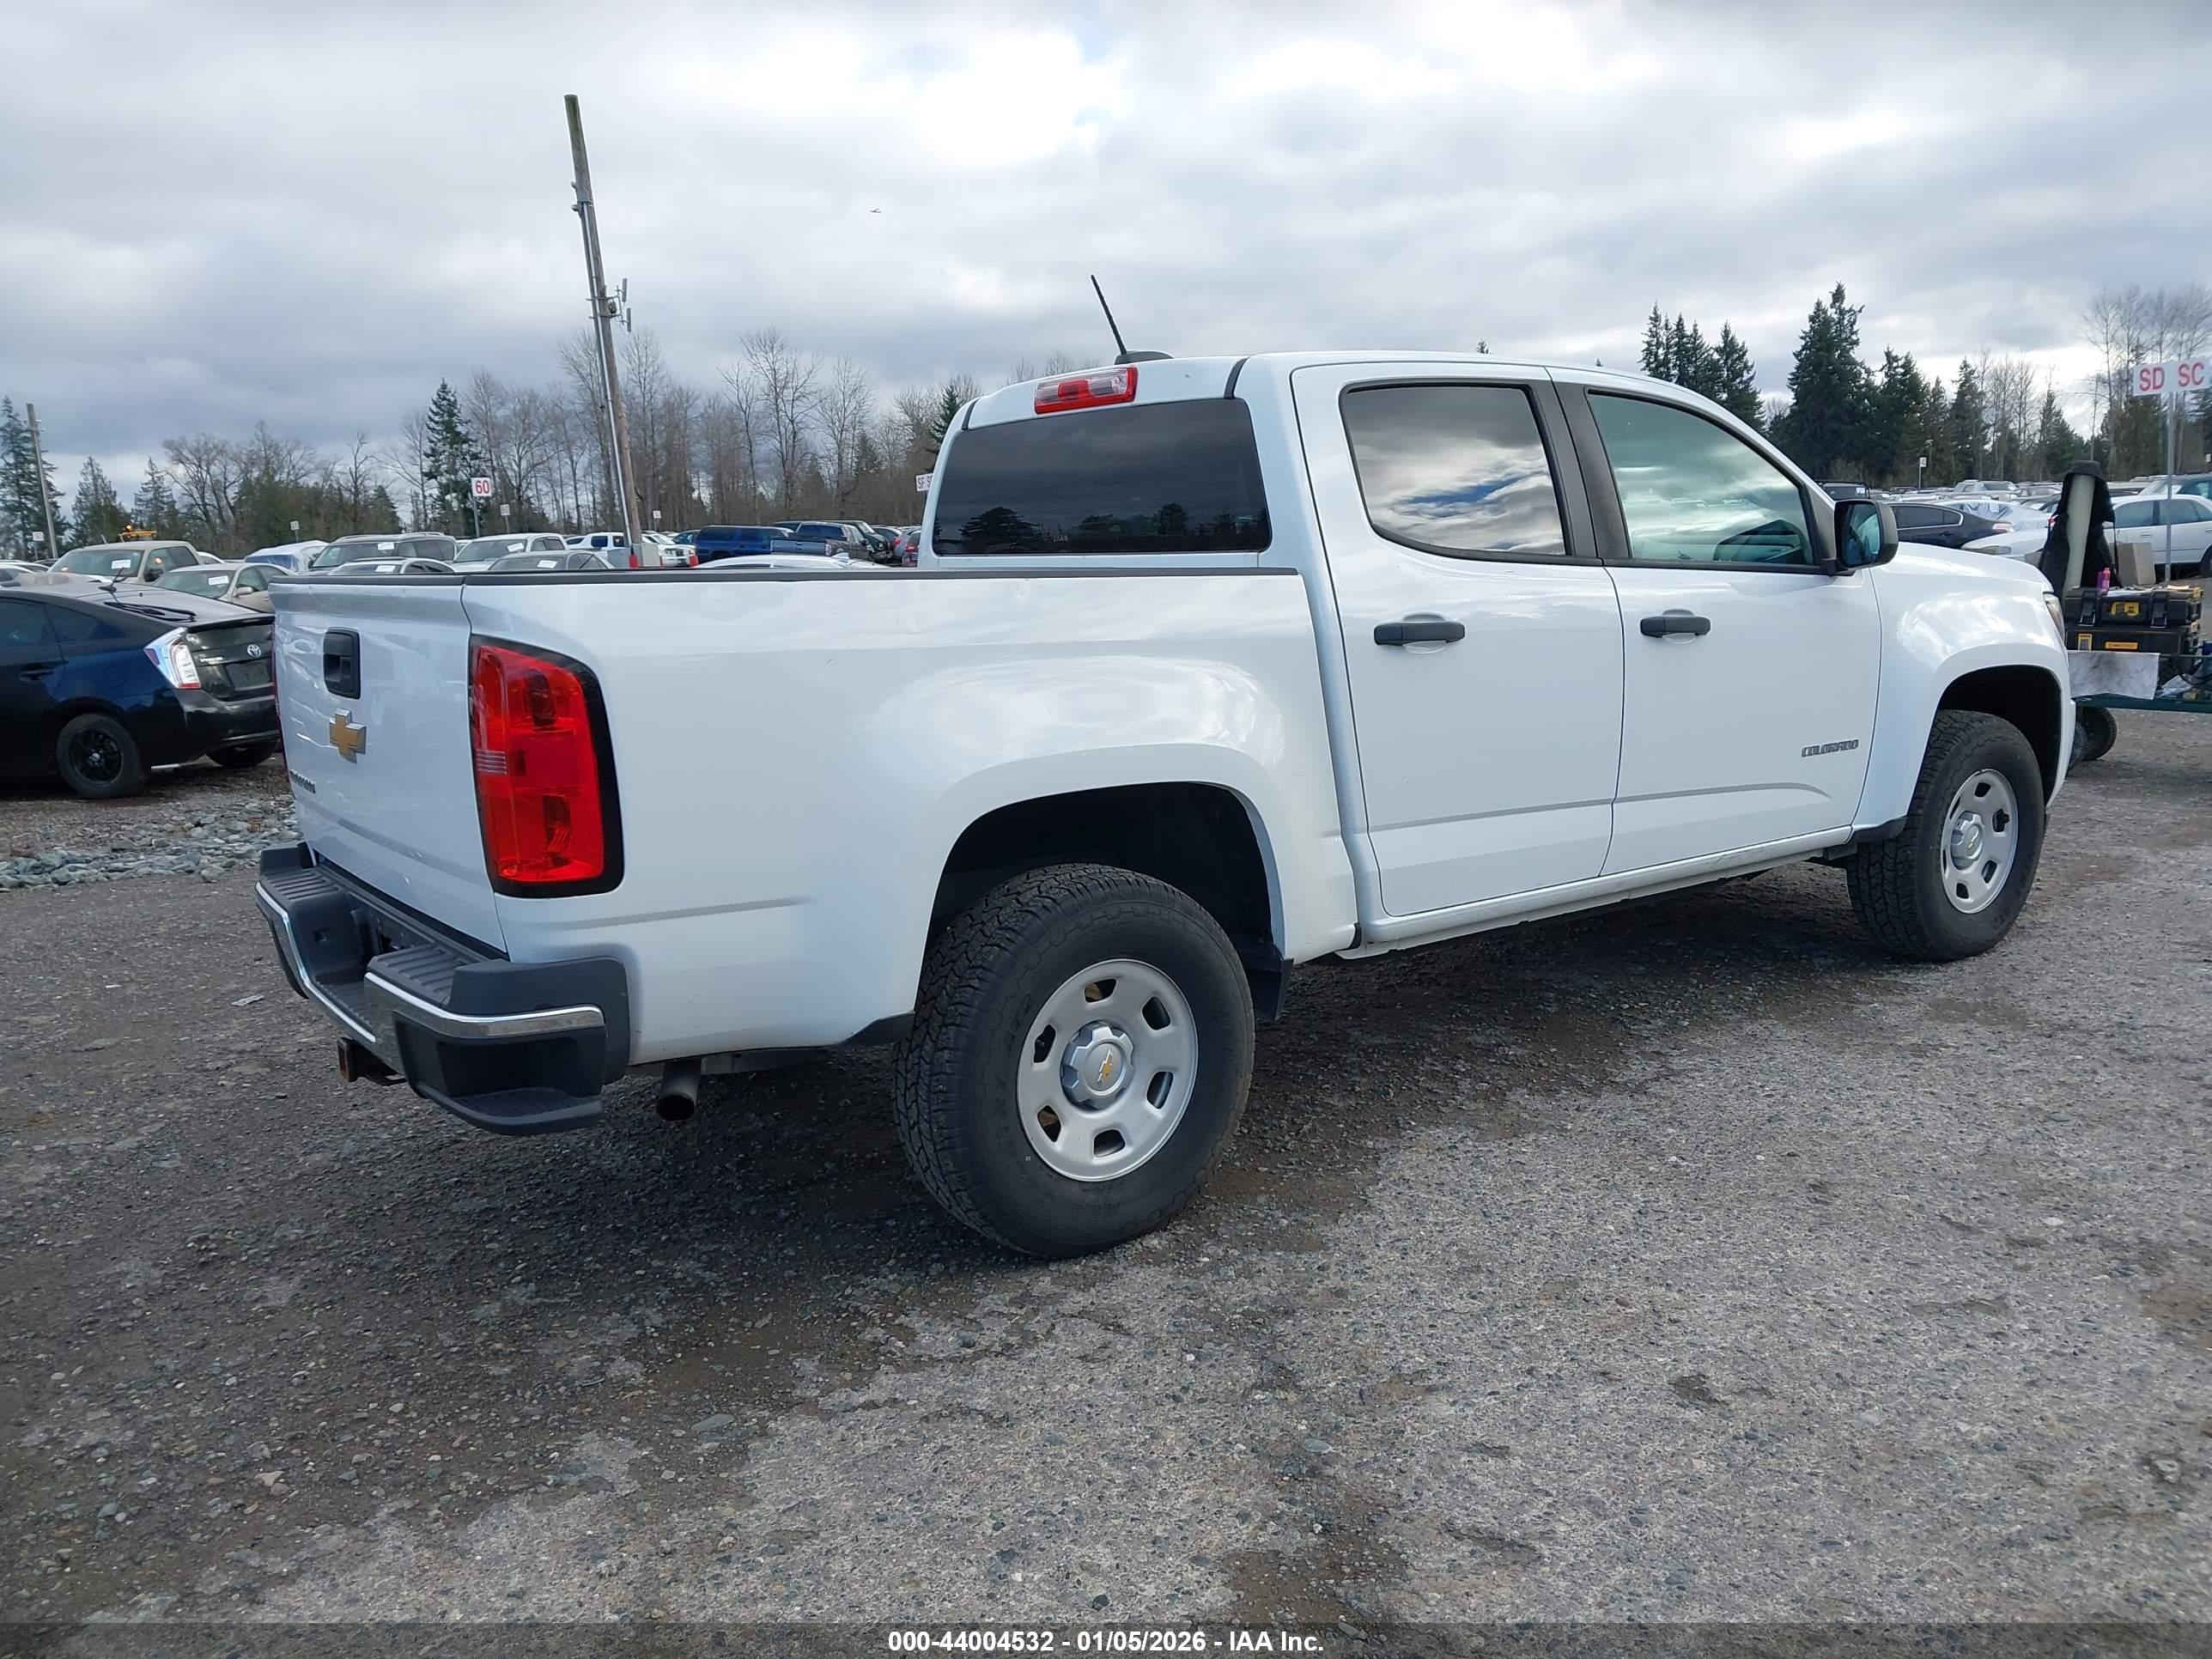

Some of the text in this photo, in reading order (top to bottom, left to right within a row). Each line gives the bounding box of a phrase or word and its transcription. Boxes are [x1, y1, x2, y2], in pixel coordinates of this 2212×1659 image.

[2139, 362, 2204, 392] SD SC
[475, 480, 489, 494] 60
